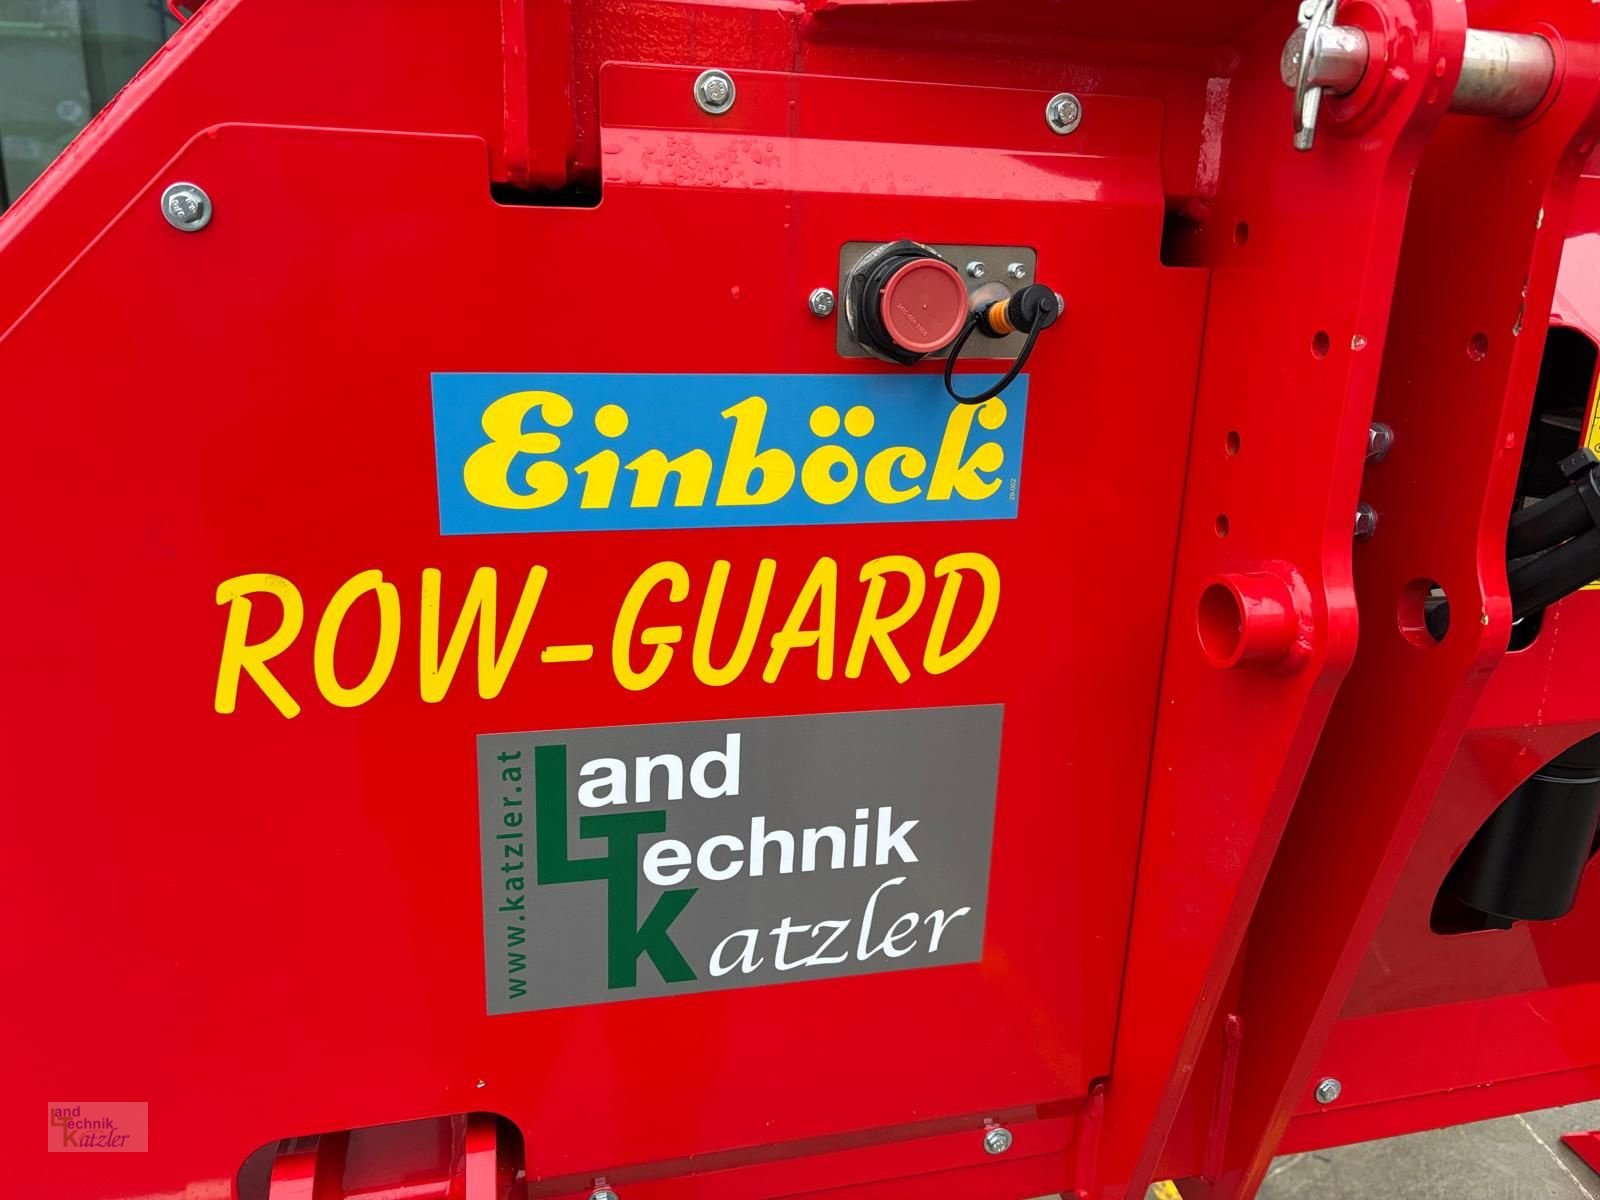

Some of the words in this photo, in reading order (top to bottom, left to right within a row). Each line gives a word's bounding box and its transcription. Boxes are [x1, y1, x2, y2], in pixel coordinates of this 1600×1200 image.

[464, 391, 1007, 509] Einböck
[214, 552, 1000, 718] ROW-GUARD
[496, 751, 527, 1000] www.katzler.at
